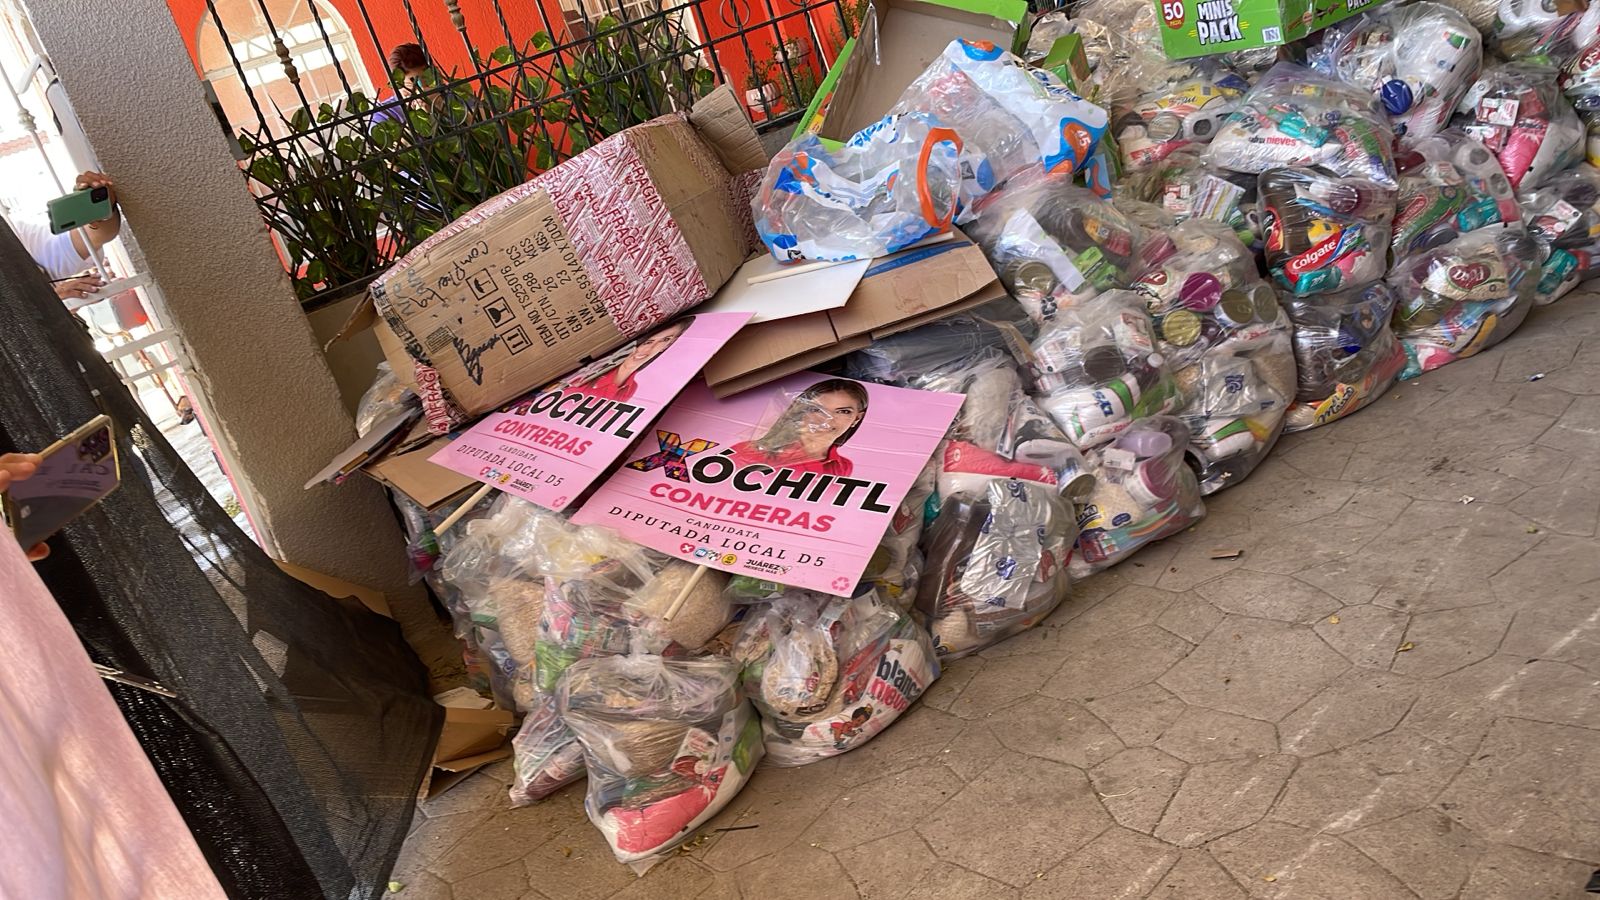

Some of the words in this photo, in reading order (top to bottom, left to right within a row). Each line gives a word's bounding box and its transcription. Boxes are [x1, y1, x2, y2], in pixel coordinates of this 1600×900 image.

[1163, 1, 1184, 20] 50
[1197, 0, 1233, 20] MINIS
[1197, 15, 1242, 45] PACK
[1266, 135, 1297, 147] nieves
[628, 159, 661, 210] FRAGIL
[542, 215, 565, 246] 70CM
[605, 208, 641, 259] FRAGIL
[506, 245, 525, 267] PCS
[520, 238, 538, 259] KGS
[558, 243, 570, 253] X
[1292, 241, 1337, 270] Colgate
[563, 252, 578, 267] 40
[571, 265, 583, 275] X
[652, 237, 686, 286] FRAGIL
[501, 265, 532, 310] TS25076
[523, 272, 542, 293] 288
[543, 277, 558, 292] 26
[556, 270, 571, 285] 23
[576, 274, 590, 289] 93
[597, 255, 631, 305] FRAGIL
[536, 324, 557, 347] ITEM
[494, 419, 593, 456] CONTRERAS
[499, 444, 538, 461] CANDIDATA
[457, 444, 505, 466] DIPUTADA
[507, 460, 544, 480] LOCAL
[545, 473, 564, 487] D5
[624, 430, 892, 514] XÓCHITL
[649, 483, 836, 533] CONTRERAS
[608, 506, 710, 544] DIPUTADA
[720, 538, 787, 560] LOCAL
[796, 554, 826, 568] D5
[686, 518, 760, 539] CANDIDATA
[746, 559, 780, 570] JUÁREZ
